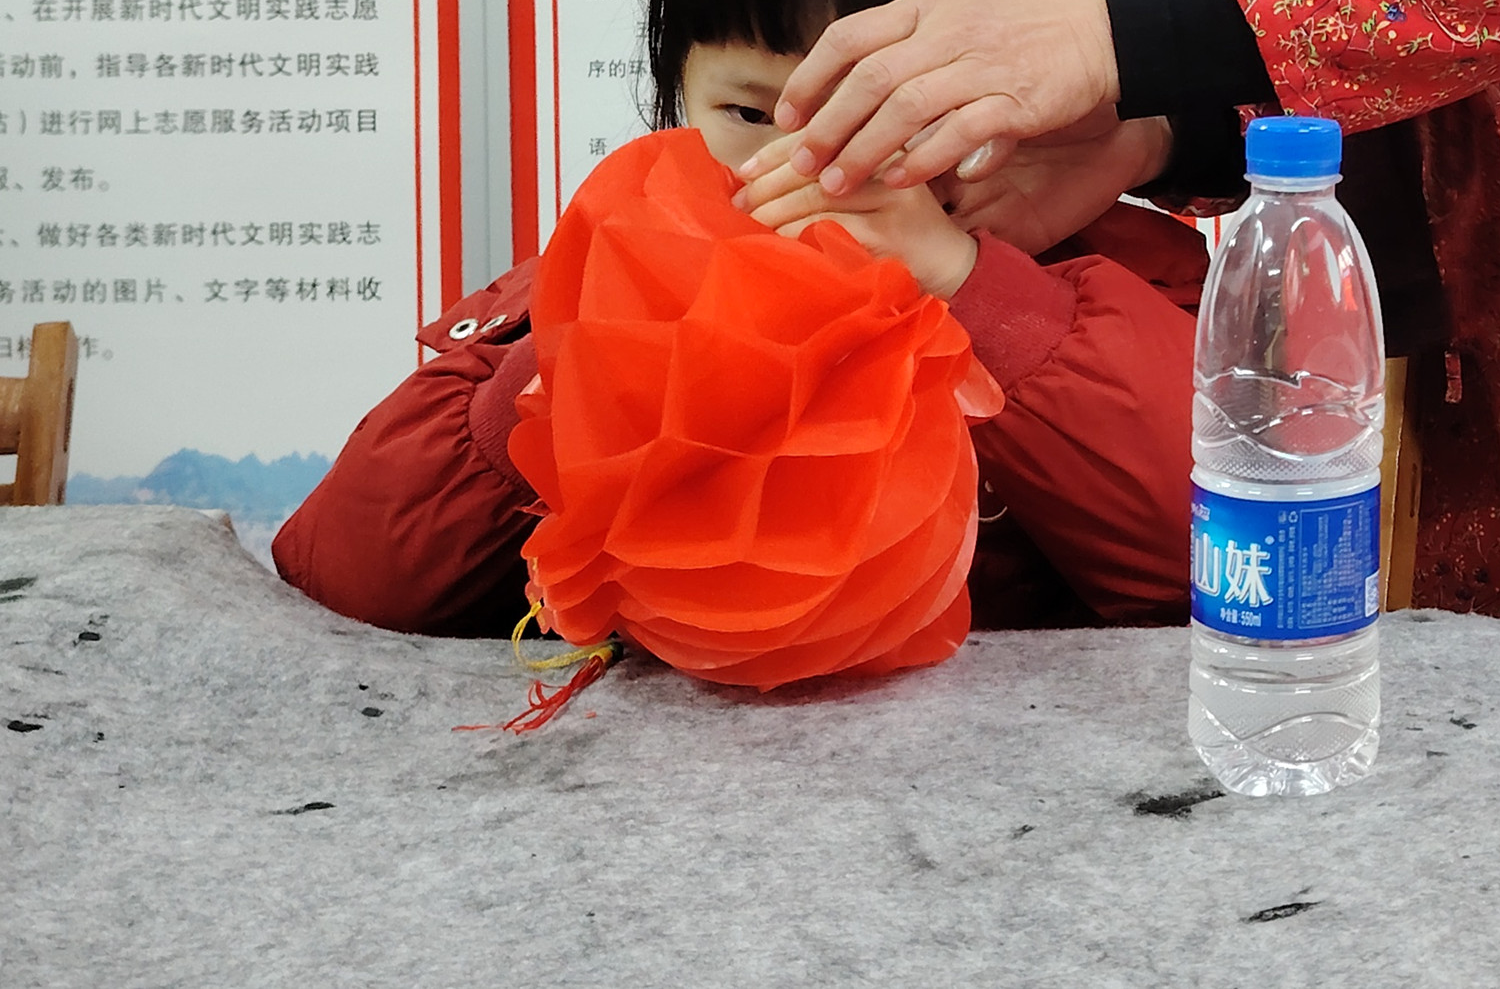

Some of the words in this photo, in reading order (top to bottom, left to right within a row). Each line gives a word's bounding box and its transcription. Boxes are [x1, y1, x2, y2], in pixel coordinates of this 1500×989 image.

[0, 53, 379, 79] 动前，指导各新时代文明实践
[0, 221, 381, 248] 、做好各类新时代文明实践志
[1190, 529, 1273, 608] 山妹
